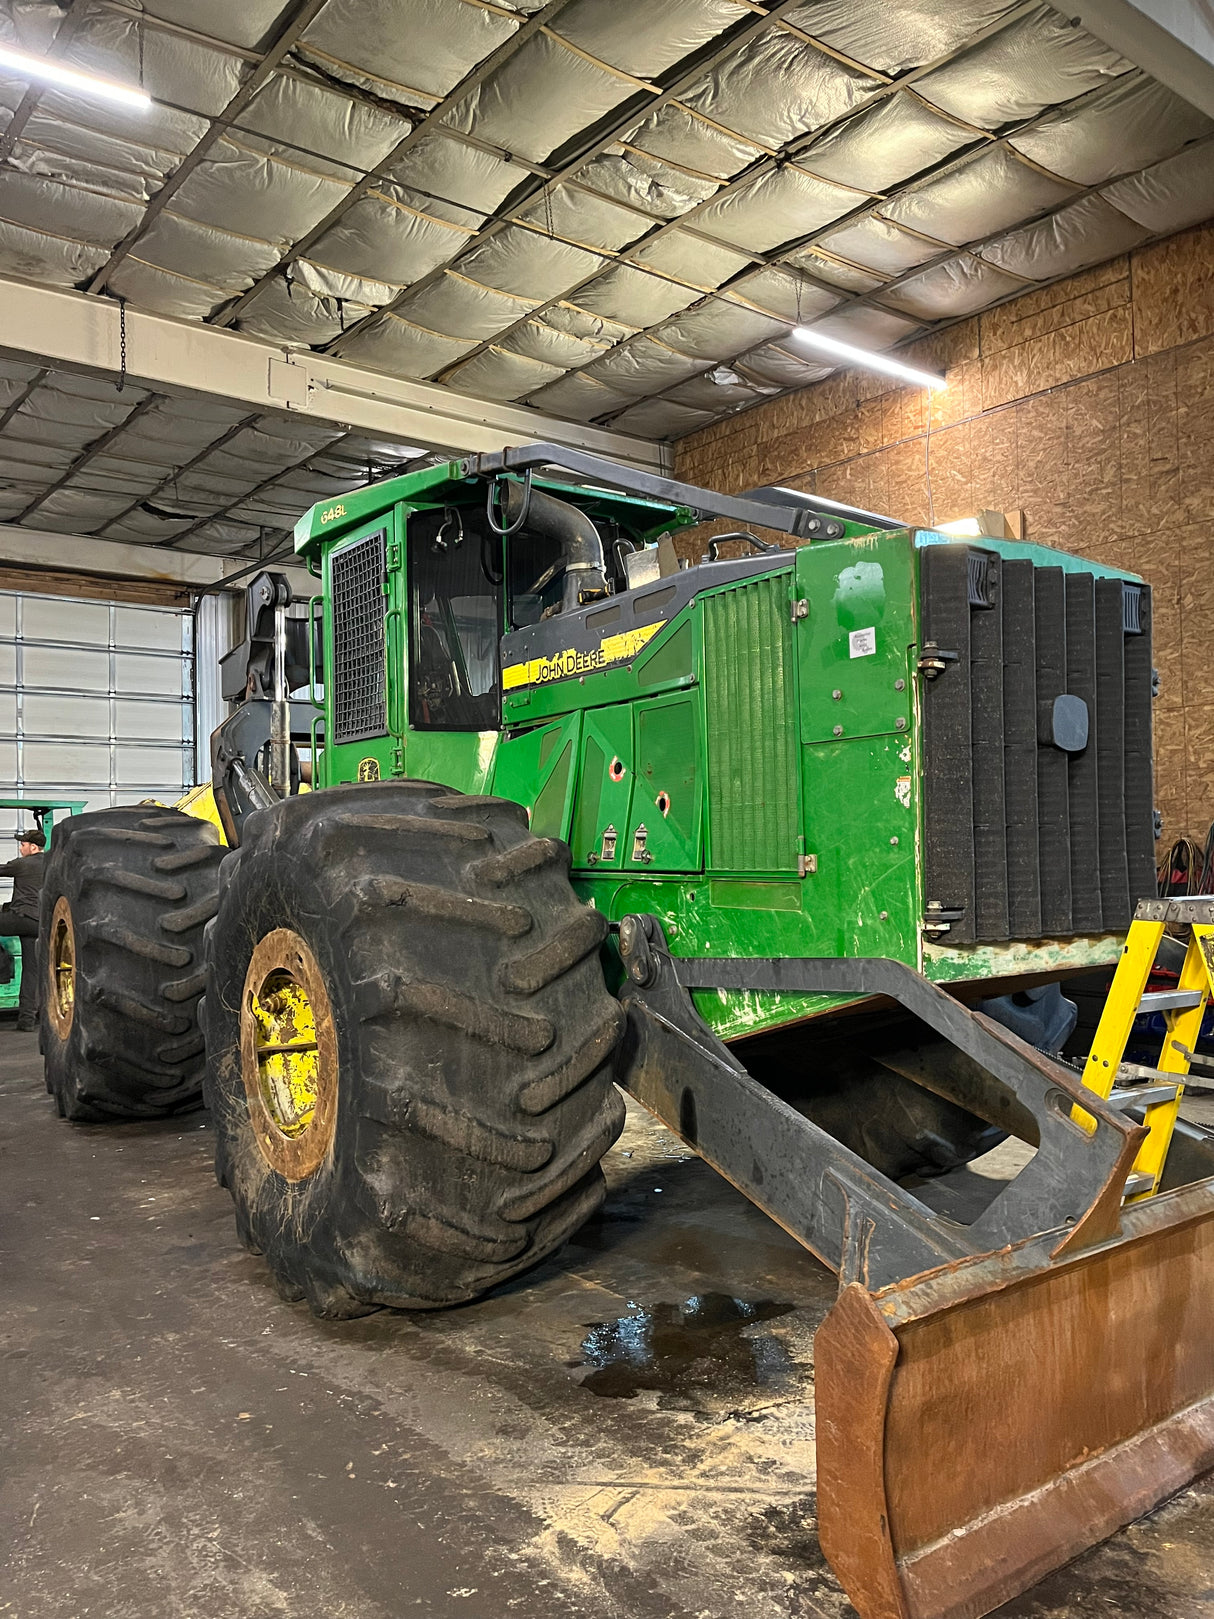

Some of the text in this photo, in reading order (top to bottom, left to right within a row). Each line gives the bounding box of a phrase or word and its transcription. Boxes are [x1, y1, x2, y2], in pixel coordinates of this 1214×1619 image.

[320, 504, 347, 524] 648L
[535, 649, 605, 681] JOHN DEERE
